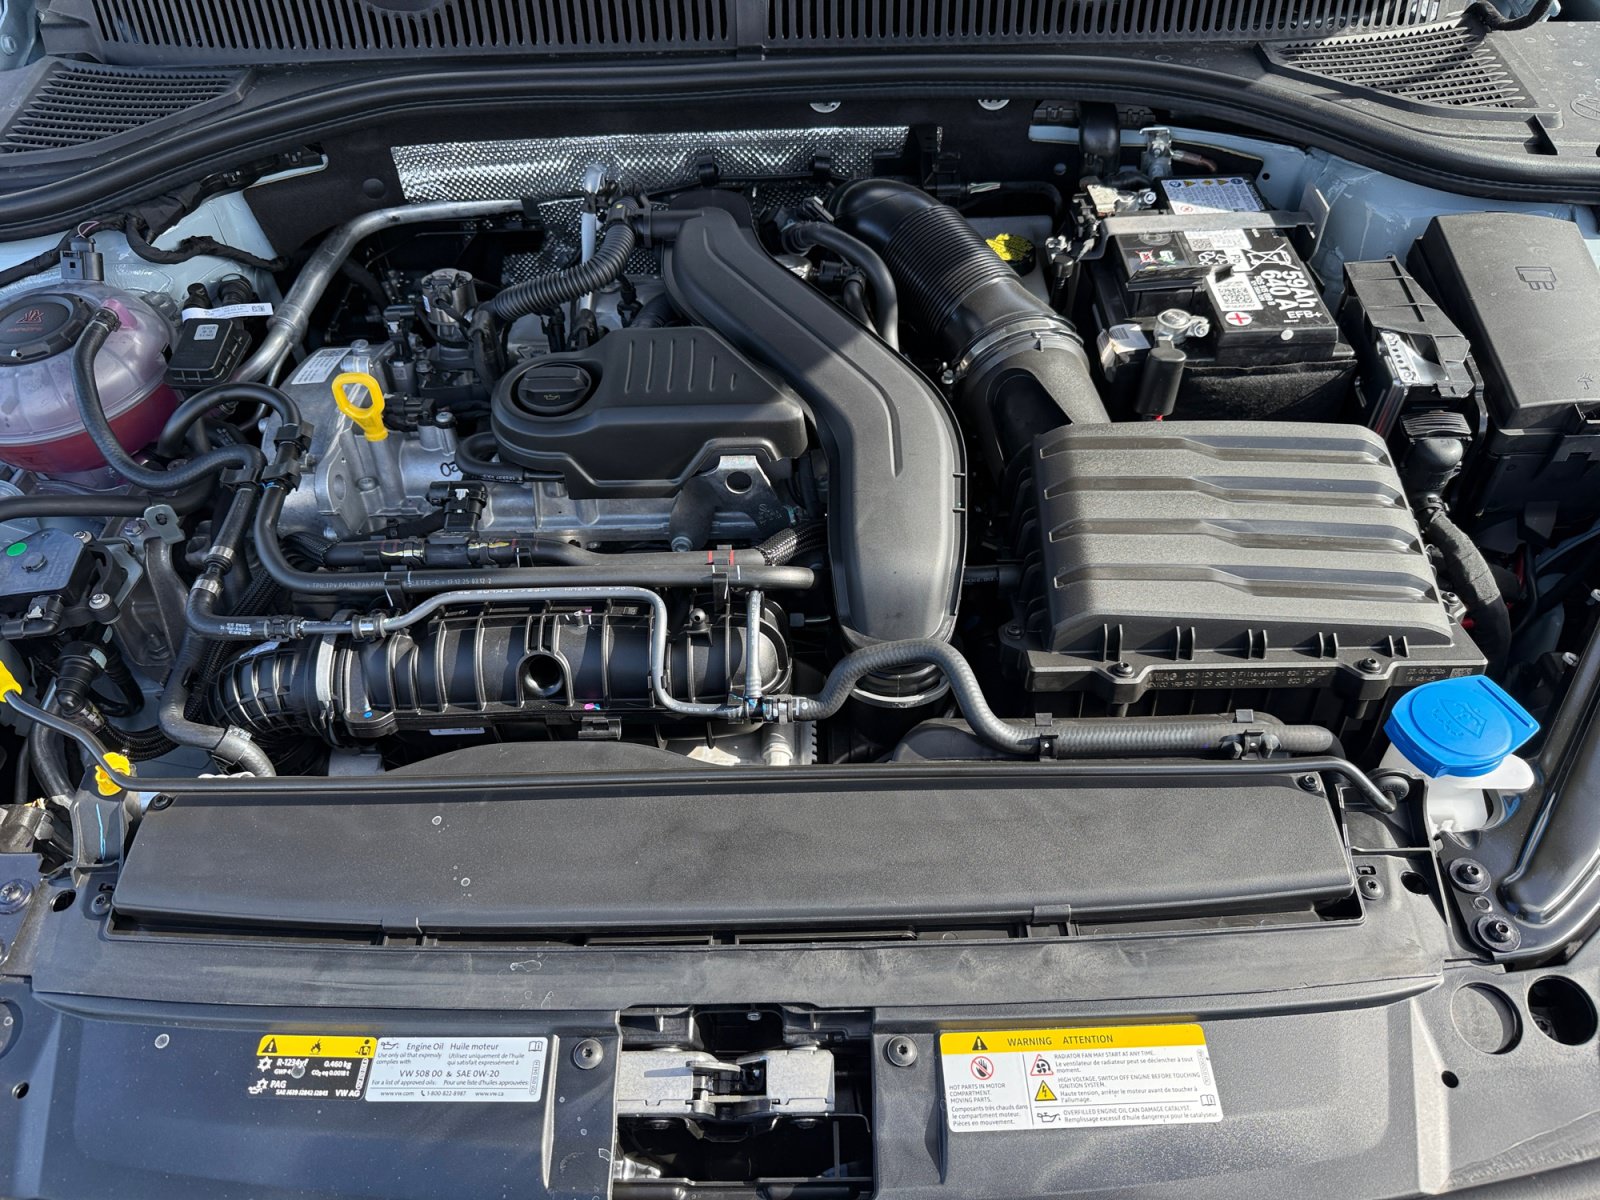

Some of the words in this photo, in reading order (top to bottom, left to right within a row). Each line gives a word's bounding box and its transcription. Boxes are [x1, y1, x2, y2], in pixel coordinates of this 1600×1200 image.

[1260, 270, 1291, 295] 640
[1282, 270, 1319, 308] 59Ah
[1274, 299, 1299, 310] A
[1286, 311, 1322, 319] EFB+
[1007, 1037, 1053, 1047] WARNING
[1063, 1034, 1114, 1044] ATTENTION
[407, 1043, 432, 1052] Engine
[419, 1053, 442, 1061] expressly
[469, 1053, 500, 1061] uniquement
[277, 1058, 309, 1068] R-1234yf
[343, 1061, 353, 1070] kg
[270, 1080, 287, 1088] PAG
[335, 1089, 349, 1097] VW
[951, 1105, 985, 1113] Composants
[958, 1112, 998, 1120] compartiment
[1065, 1115, 1099, 1123] Remplissage
